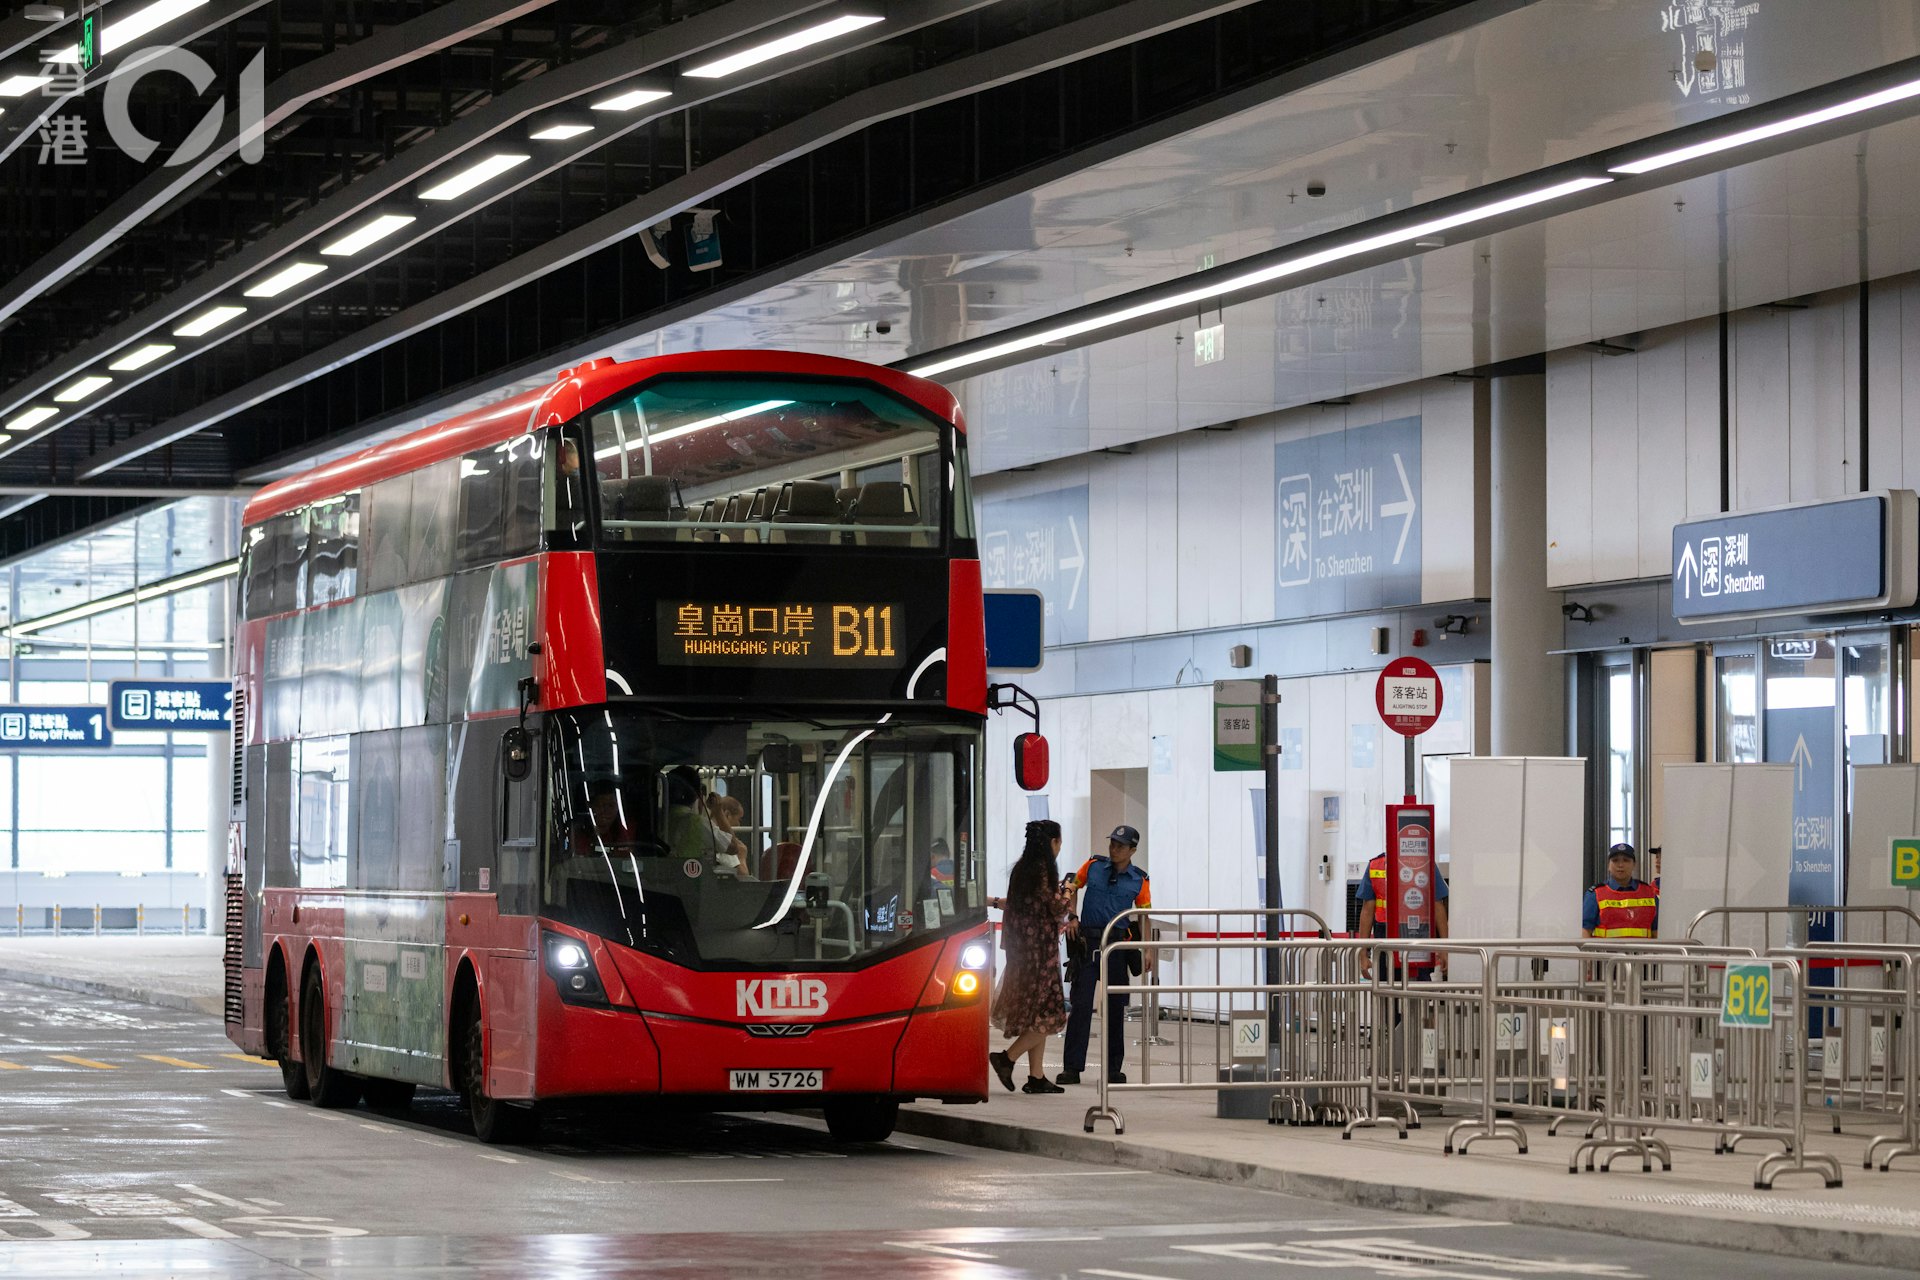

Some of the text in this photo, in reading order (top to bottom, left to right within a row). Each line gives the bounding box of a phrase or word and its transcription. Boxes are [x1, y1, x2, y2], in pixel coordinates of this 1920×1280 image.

[1318, 467, 1373, 539] 往深圳
[1283, 492, 1308, 571] 深
[1014, 527, 1055, 585] 往深圳
[1724, 533, 1749, 567] 深圳
[1315, 552, 1373, 578] To Shenzhen
[1703, 547, 1719, 588] 深
[1724, 571, 1765, 594] Shenzhen
[674, 604, 815, 637] 皇崗口岸
[832, 605, 895, 656] B11
[684, 640, 811, 655] HUANGGANG PORT
[1392, 686, 1428, 699] 落客站
[89, 714, 103, 740] 1
[155, 708, 220, 722] Drop Off Point
[1223, 718, 1250, 730] 落客站
[29, 729, 85, 742] Drop Off Point
[1794, 816, 1833, 850] 往深圳
[1795, 861, 1832, 873] To Shenzhen
[736, 979, 829, 1016] KMB
[1728, 975, 1769, 1016] B12
[735, 1072, 818, 1088] WM 5726
